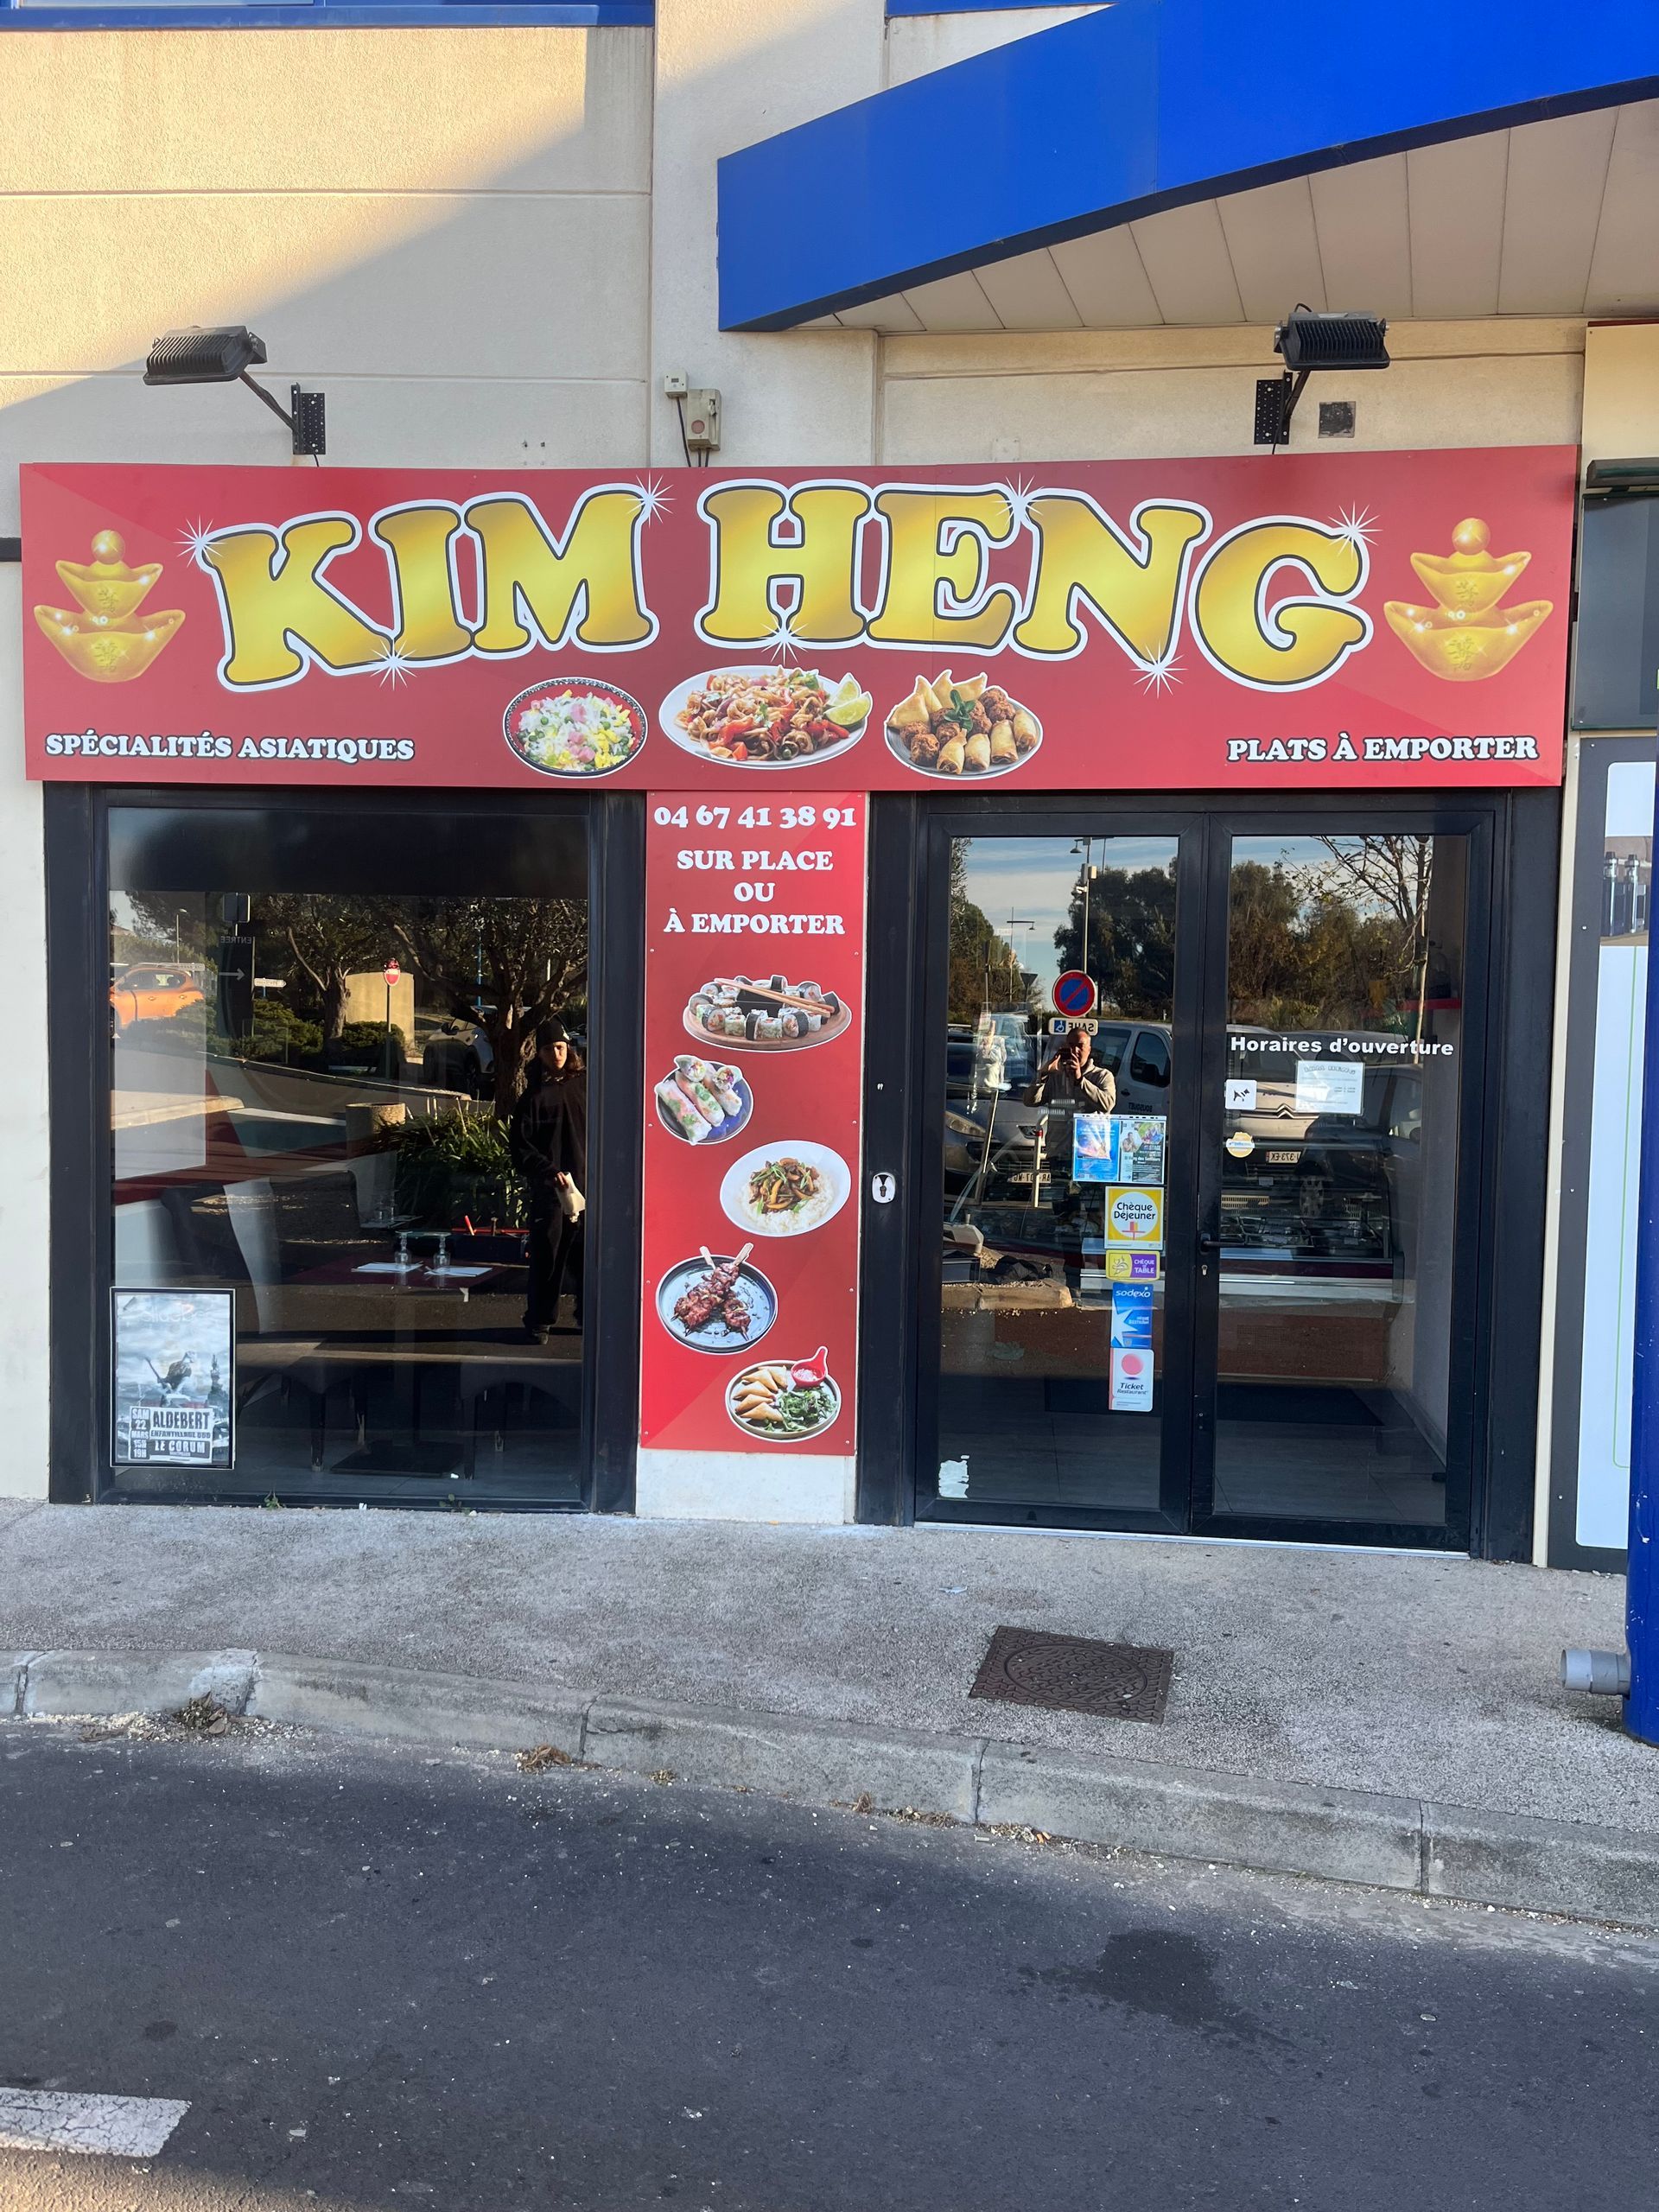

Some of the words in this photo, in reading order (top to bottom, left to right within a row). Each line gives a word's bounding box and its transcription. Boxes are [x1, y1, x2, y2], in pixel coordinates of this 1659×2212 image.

[200, 483, 660, 693] KIM
[695, 479, 1373, 693] HENG
[46, 730, 232, 759] SPÉCIALITÉS
[237, 736, 415, 765] ASIATIQUES
[1227, 738, 1327, 760] PLATS
[1332, 732, 1357, 760] À
[1363, 736, 1539, 760] EMPORTER
[654, 806, 689, 828] 04
[696, 804, 731, 830] 67
[737, 806, 772, 829] 41
[779, 805, 816, 830] 38
[823, 807, 857, 830] 91
[677, 849, 735, 870] SUR
[741, 850, 834, 871] PLACE
[734, 882, 776, 902] OU
[664, 907, 685, 933] À
[691, 912, 846, 935] EMPORTER
[1230, 1036, 1322, 1052] Horaires
[1329, 1038, 1454, 1056] d'ouverture
[1116, 1201, 1153, 1212] Chèque
[1116, 1287, 1151, 1298] sodexo
[132, 1408, 149, 1420] SAM
[153, 1411, 210, 1429] ALDEBERT
[135, 1420, 147, 1430] 22
[131, 1430, 149, 1440] MARS
[133, 1448, 147, 1459] 19H
[155, 1440, 168, 1452] LE
[168, 1440, 206, 1452] CORUM
